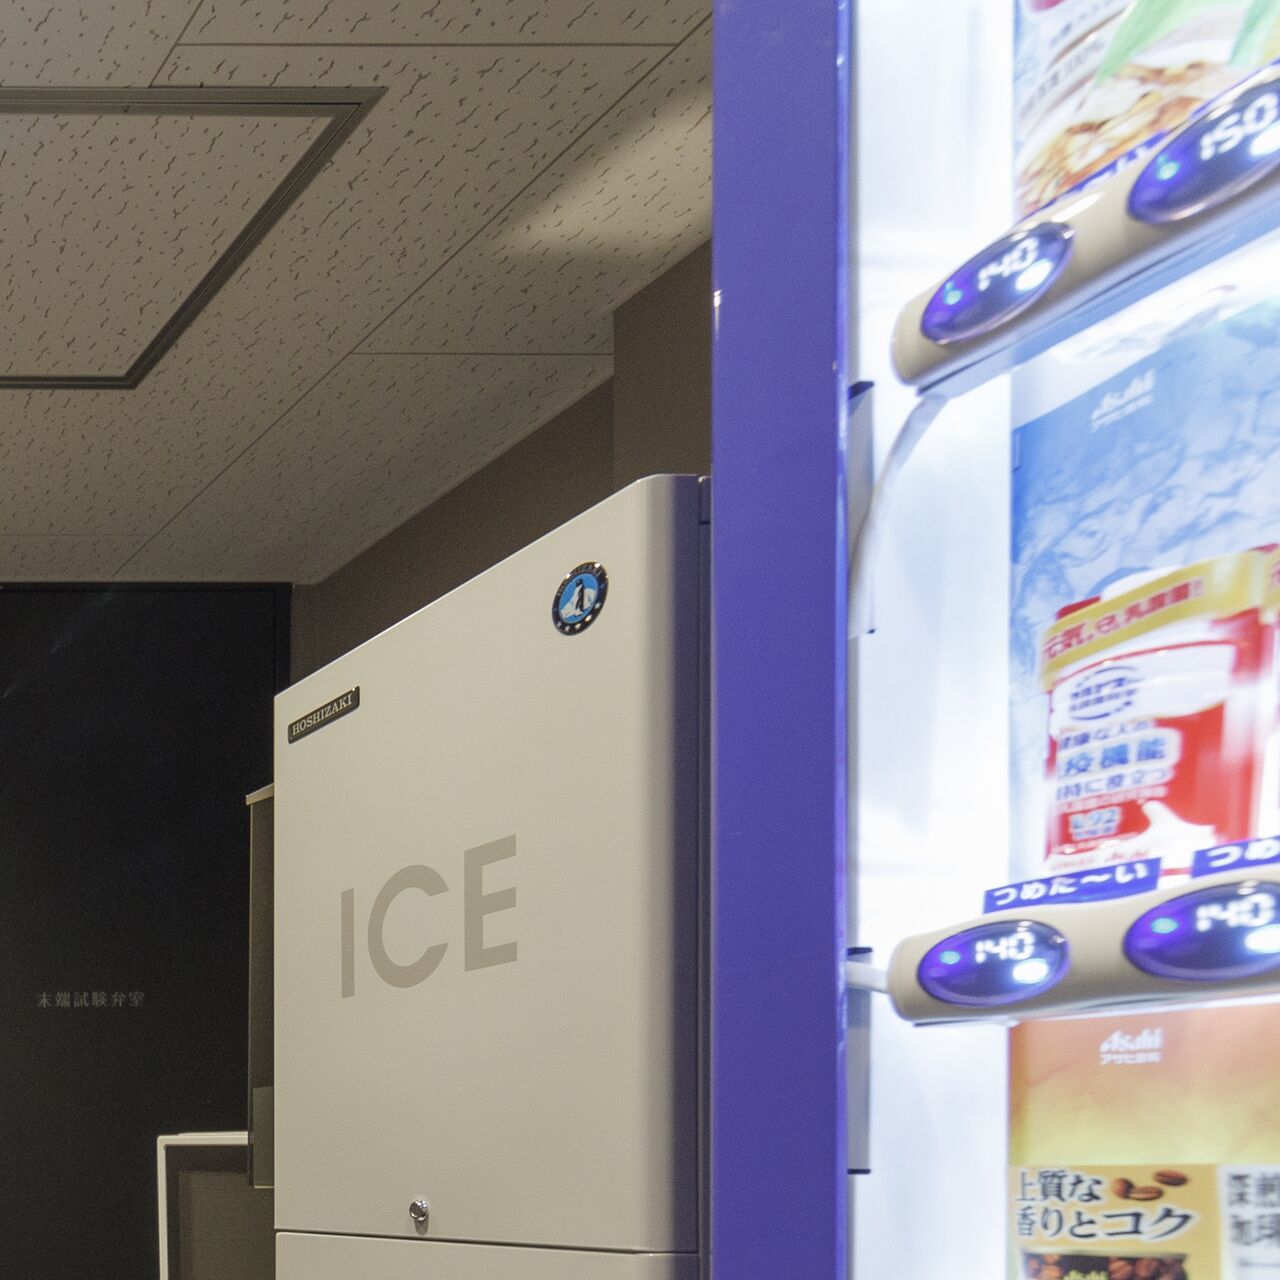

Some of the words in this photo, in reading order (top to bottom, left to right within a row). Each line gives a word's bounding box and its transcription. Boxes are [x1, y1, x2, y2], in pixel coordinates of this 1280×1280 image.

[1200, 92, 1280, 161] 150
[977, 236, 1039, 291] 140
[291, 693, 353, 737] HOSHIZAKI
[341, 834, 518, 999] ICE
[1195, 892, 1277, 933] 140
[974, 930, 1036, 964] 140
[37, 991, 146, 1009] 末端試験弁室
[1099, 1027, 1163, 1053] Asahi
[1017, 1168, 1103, 1202] 上質な
[1017, 1206, 1193, 1240] 香りとコク
